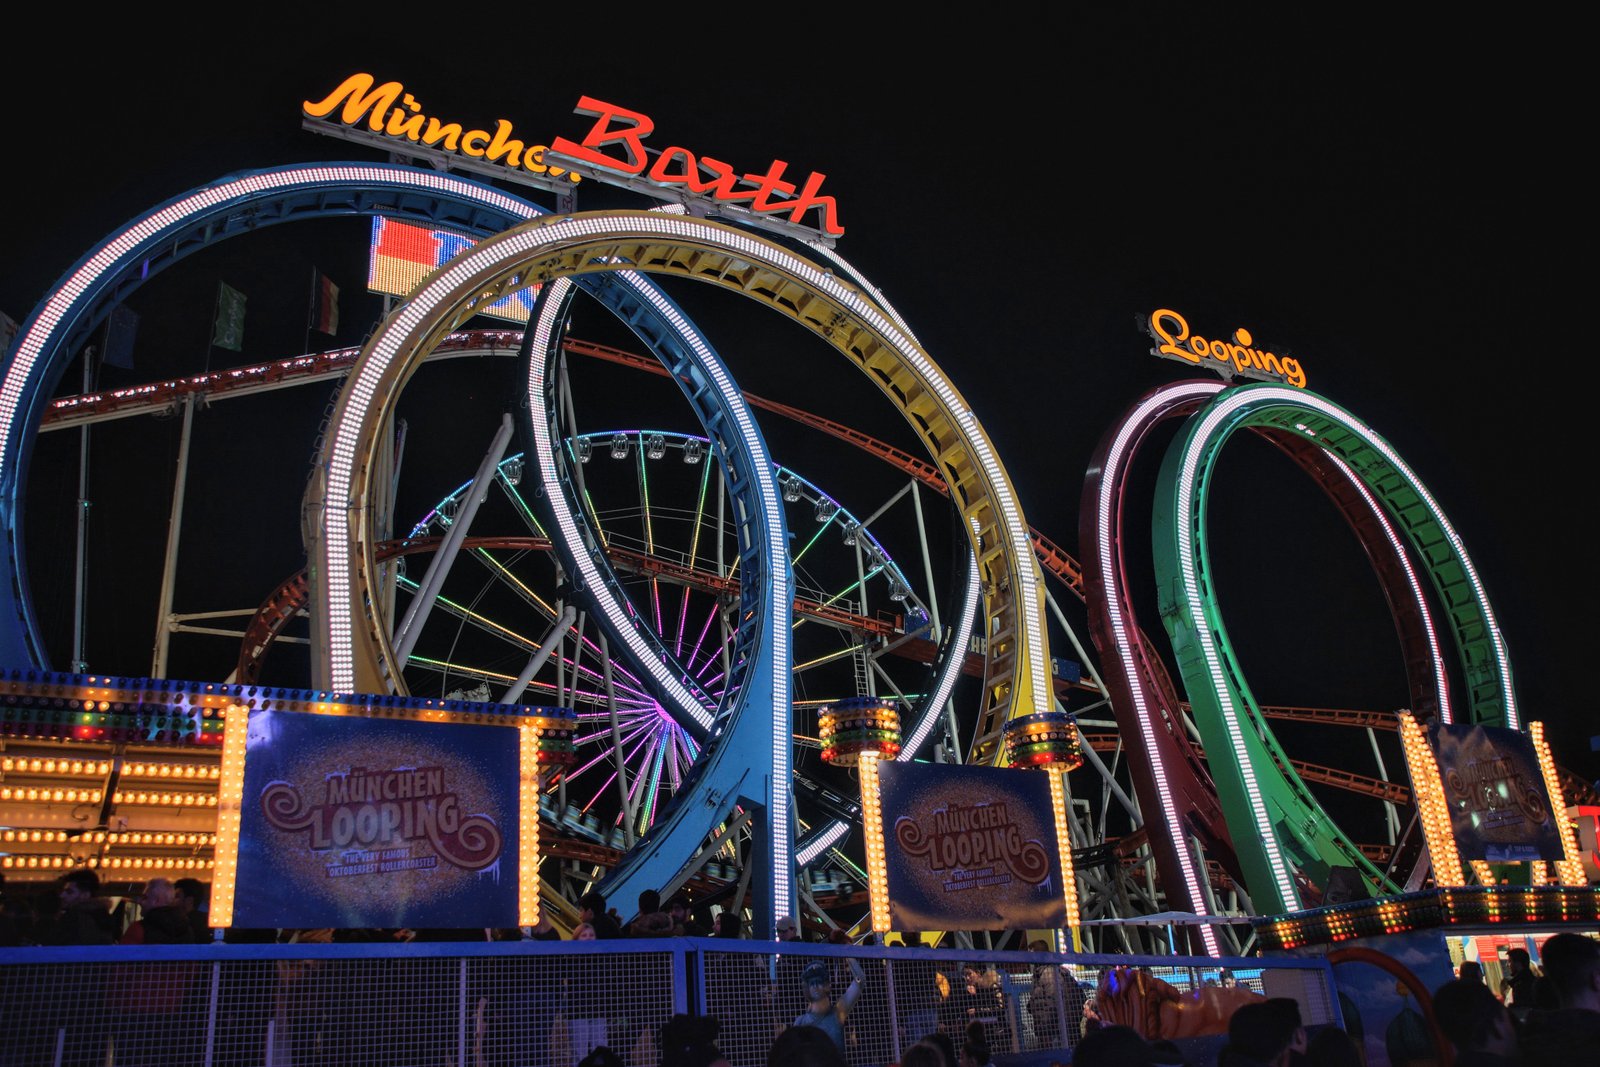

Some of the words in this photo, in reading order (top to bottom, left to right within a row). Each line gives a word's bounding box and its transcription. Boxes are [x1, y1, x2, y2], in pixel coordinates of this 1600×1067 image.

[303, 73, 582, 182] Münche
[551, 95, 845, 234] Barth
[1151, 308, 1307, 389] Looping
[329, 769, 443, 804] MÜNCHEN
[312, 798, 459, 849] LOOPING
[936, 806, 1008, 834] MÜNCHEN
[329, 863, 377, 877] OKTOBERFEST
[380, 856, 436, 872] ROLLERCOASTER
[346, 853, 359, 864] THE
[362, 851, 379, 862] VERY
[382, 848, 410, 860] FAMOUS
[929, 826, 1021, 869] LOOPING
